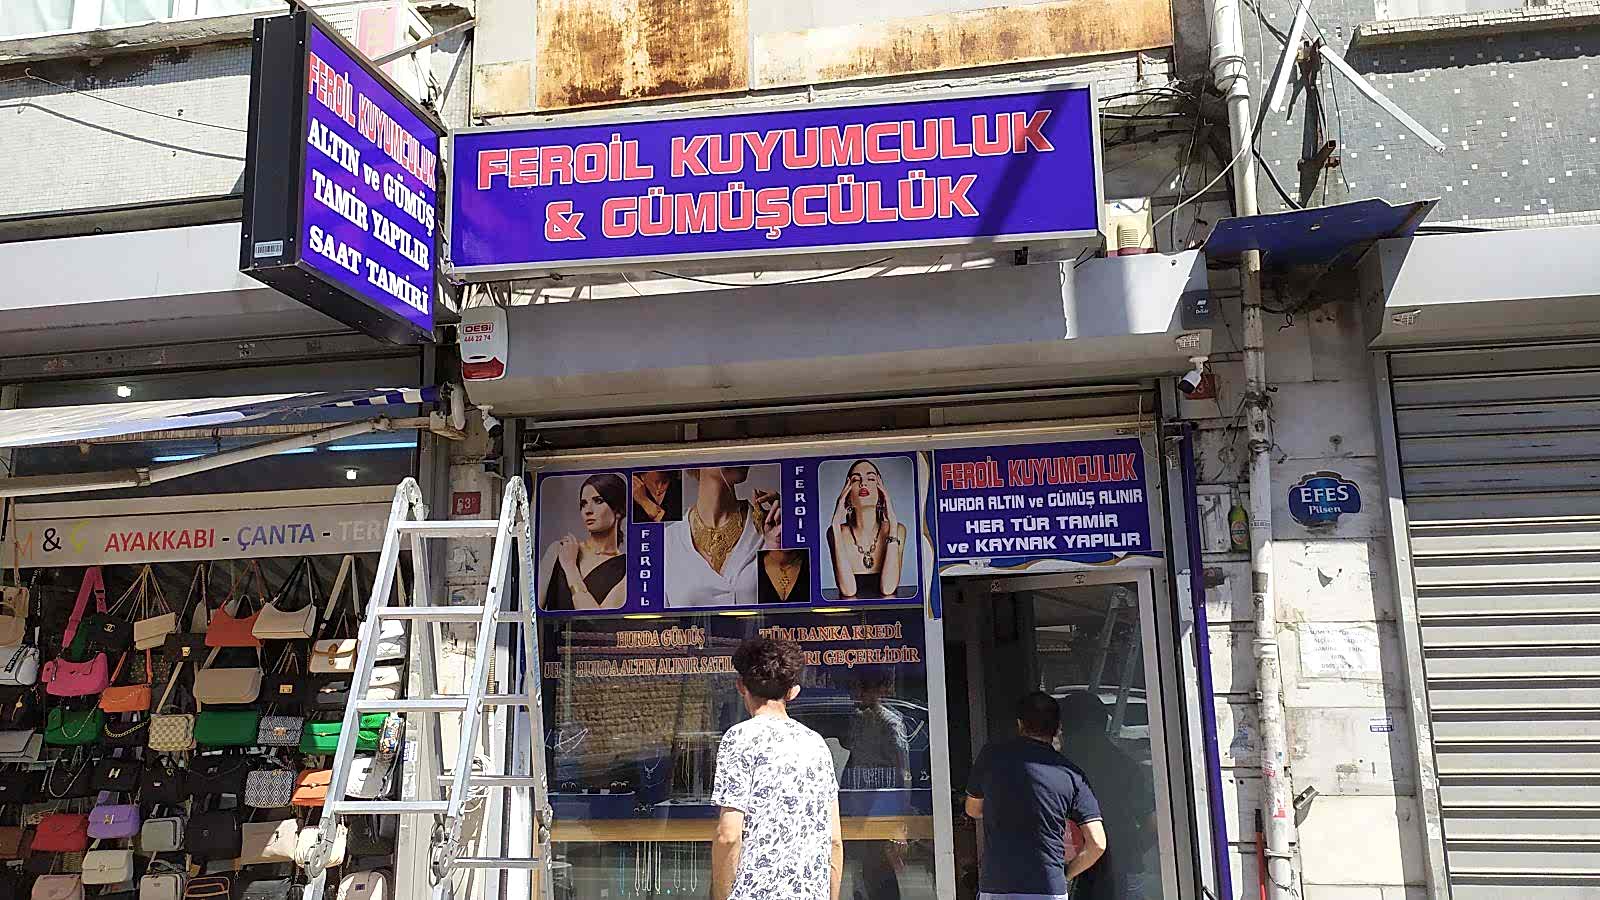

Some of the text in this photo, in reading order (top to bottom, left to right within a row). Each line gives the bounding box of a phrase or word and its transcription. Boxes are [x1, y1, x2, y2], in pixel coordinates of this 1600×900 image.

[308, 51, 437, 191] FEROİL KUYUMCULUK
[477, 110, 1056, 191] FEROİL KUYUMCULUK
[307, 118, 435, 236] ALTIN ve GÜMÜŞ
[544, 170, 980, 242] & GÜMÜŞCÜLÜK
[312, 169, 430, 271] TAMİR YAPILIR
[309, 225, 430, 316] SAAT TAMİRİ
[941, 453, 1138, 491] FEROİL KUYUMCULUK
[939, 488, 1143, 513] HURDA ALTIN ve GÜMÜŞ ALINIR
[1299, 485, 1350, 503] EFES
[966, 511, 1119, 534] HER TÜR TAMİR
[1308, 505, 1342, 516] Pilsen
[42, 527, 62, 552] &
[104, 528, 215, 552] AYAKKABI
[237, 523, 315, 551] ÇANTA
[338, 519, 388, 541] TER
[947, 532, 1141, 553] ve KAYNAK YAPILIR
[616, 625, 705, 649] HURDA GÜMÜŞ
[759, 621, 902, 642] TÜM BANKA KREDİ
[575, 660, 619, 678] HURDA
[620, 658, 656, 676] ALTIN
[657, 657, 699, 675] ALINIR
[701, 655, 739, 673] SATIL
[823, 645, 921, 669] GEÇERLİDİR
